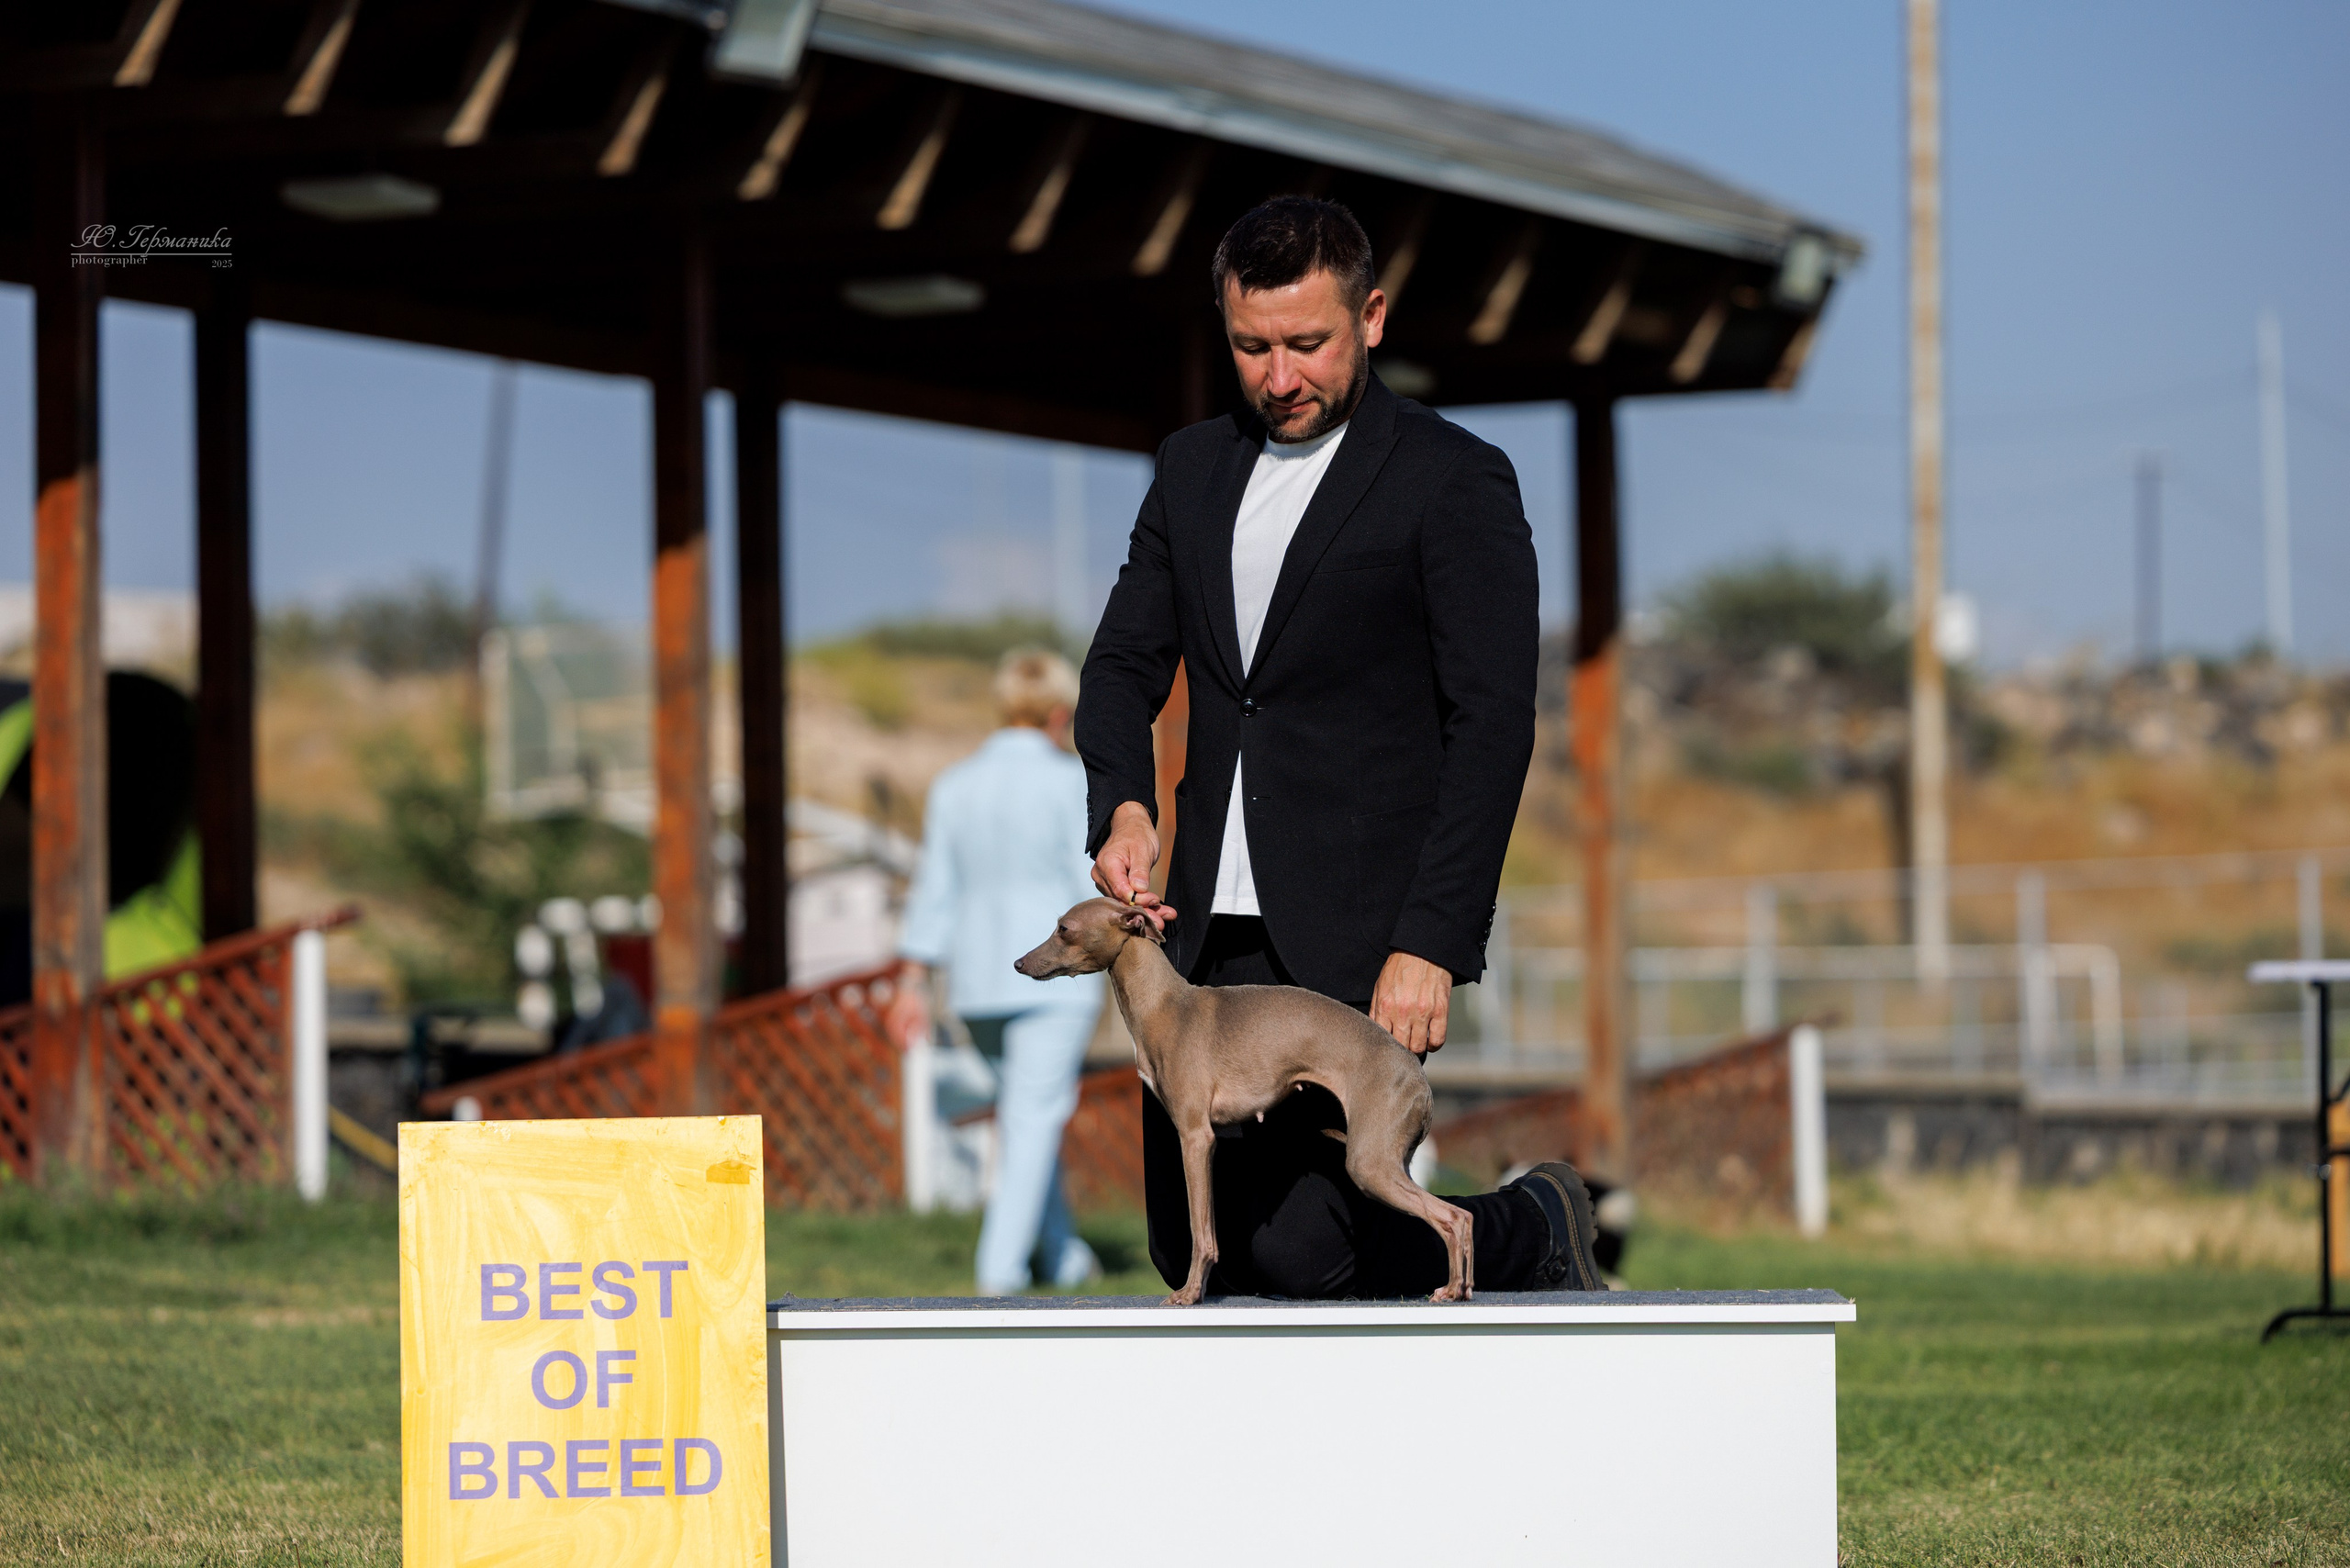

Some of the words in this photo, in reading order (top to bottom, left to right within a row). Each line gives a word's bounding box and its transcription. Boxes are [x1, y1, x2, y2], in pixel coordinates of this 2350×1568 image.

[480, 1260, 688, 1321] BEST
[531, 1350, 636, 1410] OF
[449, 1438, 722, 1500] BREED
